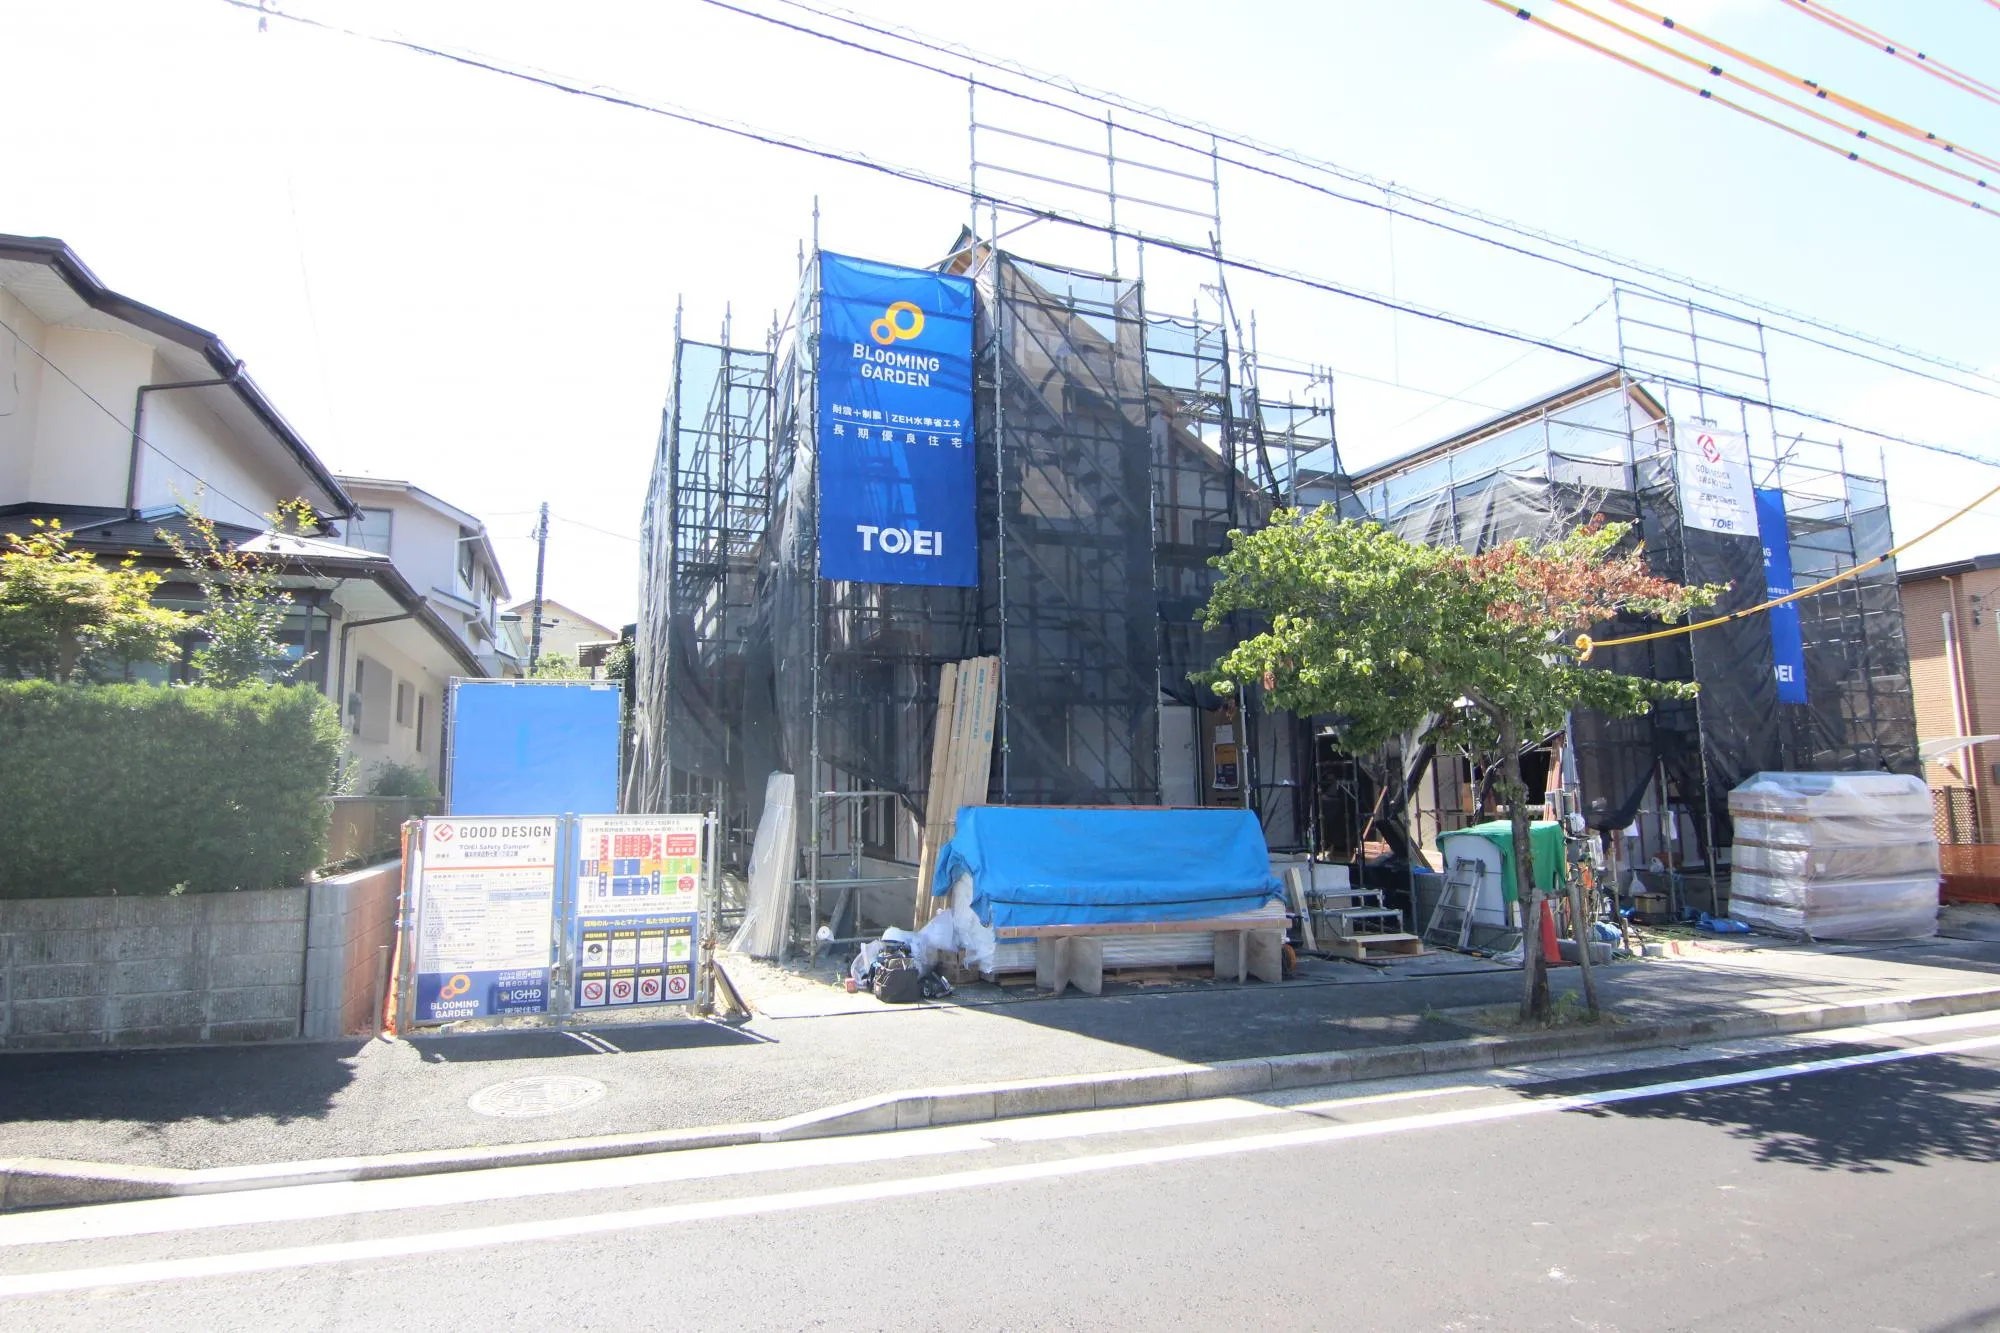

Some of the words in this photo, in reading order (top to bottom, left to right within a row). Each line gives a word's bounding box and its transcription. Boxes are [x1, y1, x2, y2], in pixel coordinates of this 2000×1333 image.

[853, 343, 940, 372] BLOOMING
[861, 363, 930, 387] GARDEN
[833, 424, 962, 448] 長期優良住宅
[460, 826, 497, 838] GOOD
[502, 825, 551, 838] DESIGN
[511, 989, 541, 1000] IGHD
[430, 999, 479, 1010] BLOOMING
[435, 1008, 473, 1018] GARDEN
